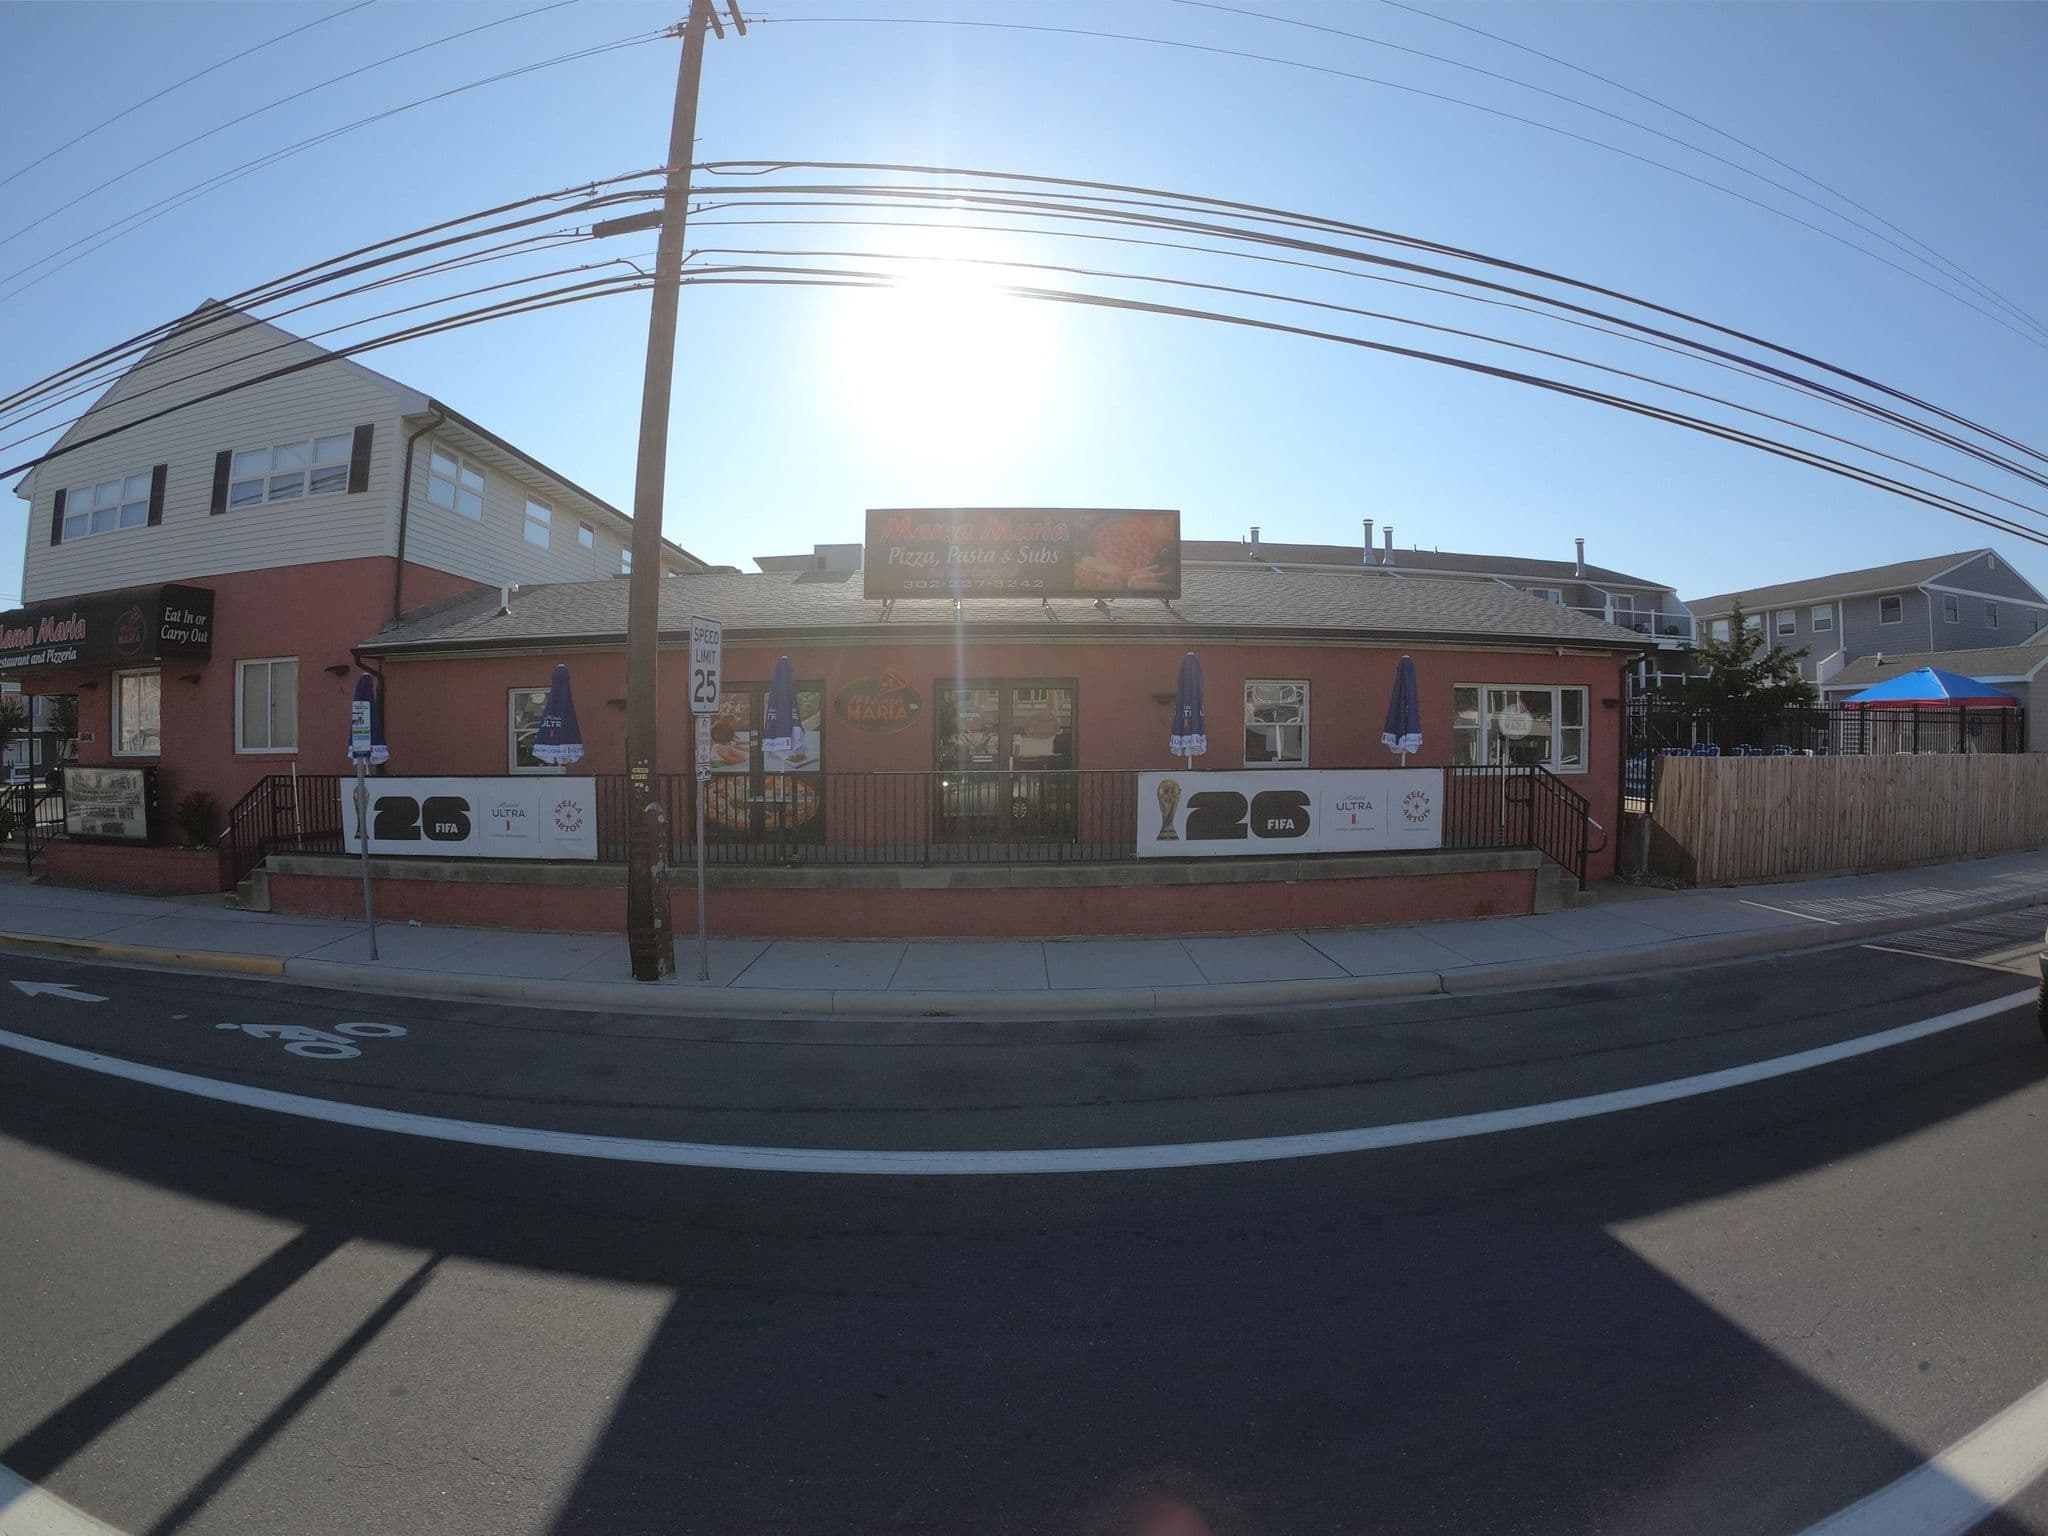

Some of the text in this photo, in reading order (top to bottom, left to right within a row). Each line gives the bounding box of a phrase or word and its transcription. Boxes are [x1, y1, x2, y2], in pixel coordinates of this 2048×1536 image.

[981, 518, 1069, 542] Maria
[888, 545, 1059, 567] Pizza, Pasta & Subs
[165, 607, 207, 625] Eat In or
[0, 613, 86, 649] ama Maria
[161, 624, 208, 645] Carry Out
[694, 627, 719, 645] SPEED
[31, 650, 46, 664] and
[47, 647, 77, 664] Pizzeria
[696, 648, 716, 664] LIMIT
[694, 669, 716, 703] 25
[554, 799, 583, 814] STELLA
[1336, 801, 1373, 811] ULTRA
[1403, 790, 1431, 806] STELLA
[374, 796, 471, 841] 26
[492, 808, 526, 818] ULTRA
[1186, 790, 1311, 841] 26
[1403, 808, 1431, 823] ARTOIS
[435, 822, 459, 833] FIFA
[554, 817, 584, 833] ARTOIS
[1267, 818, 1295, 830] FIFA
